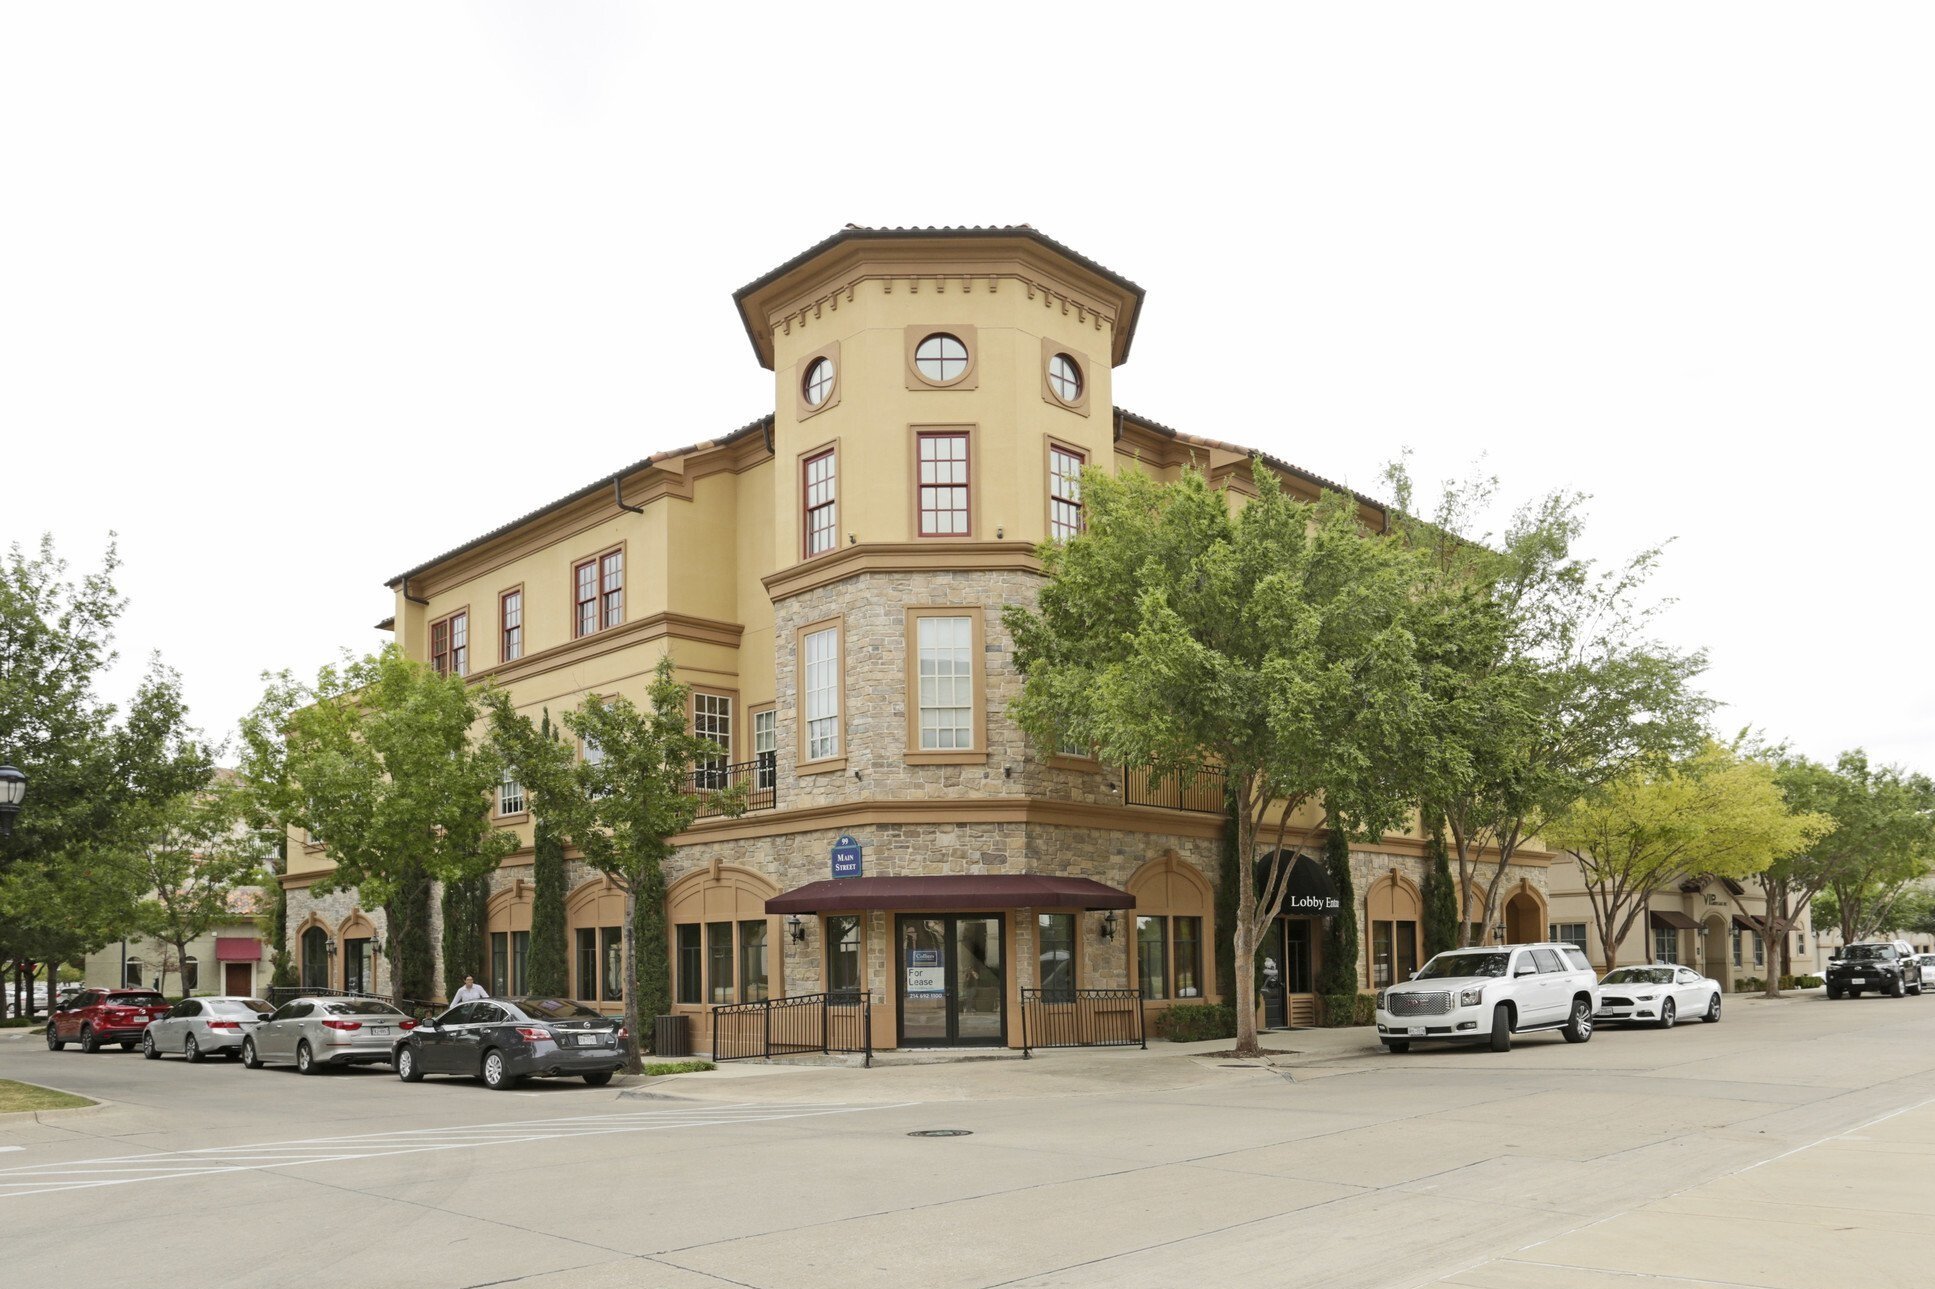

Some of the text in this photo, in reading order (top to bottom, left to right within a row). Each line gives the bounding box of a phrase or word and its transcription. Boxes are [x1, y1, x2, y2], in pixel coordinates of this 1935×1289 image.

[835, 863, 856, 871] STREET
[1291, 896, 1324, 910] Lobby
[908, 968, 923, 977] For
[908, 978, 933, 986] Lease
